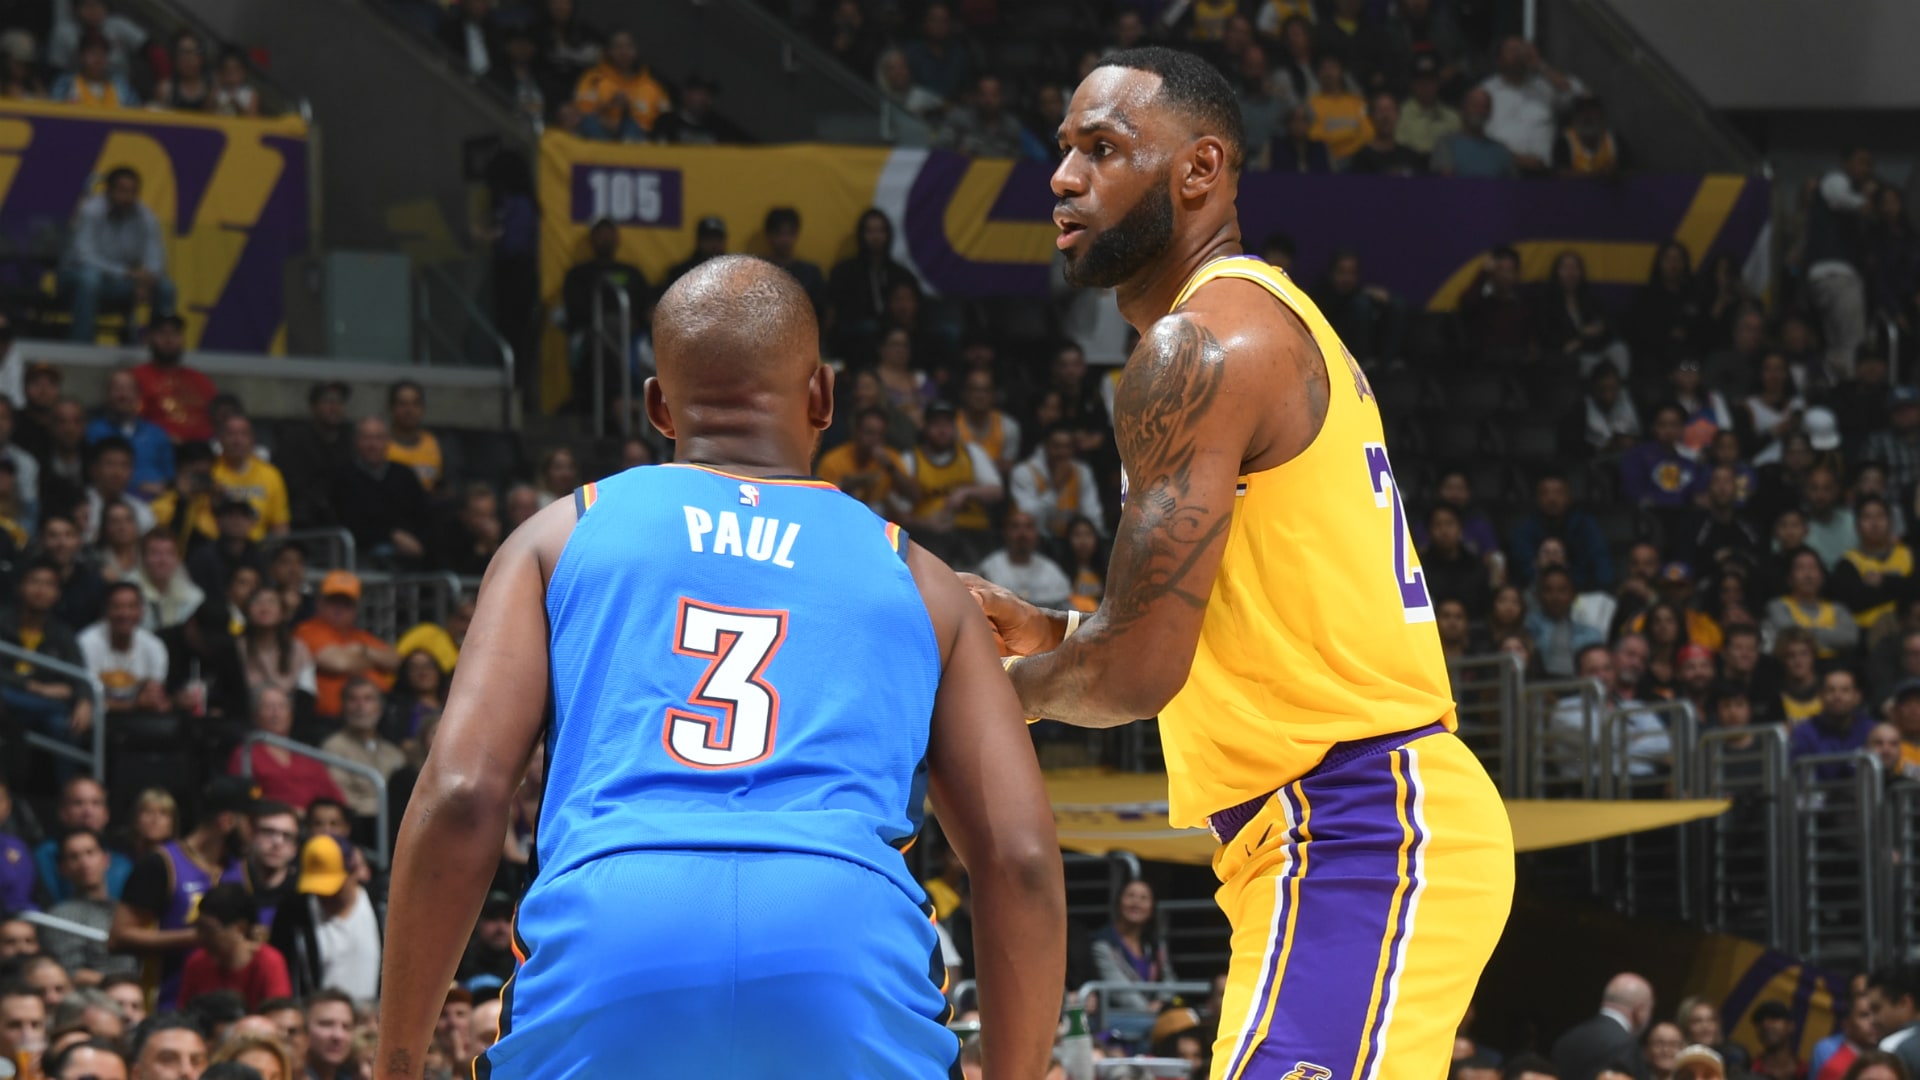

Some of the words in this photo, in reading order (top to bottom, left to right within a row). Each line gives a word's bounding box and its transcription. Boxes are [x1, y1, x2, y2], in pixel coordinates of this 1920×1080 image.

[588, 171, 661, 222] 105
[683, 505, 801, 569] PAUL
[662, 595, 789, 771] 3
